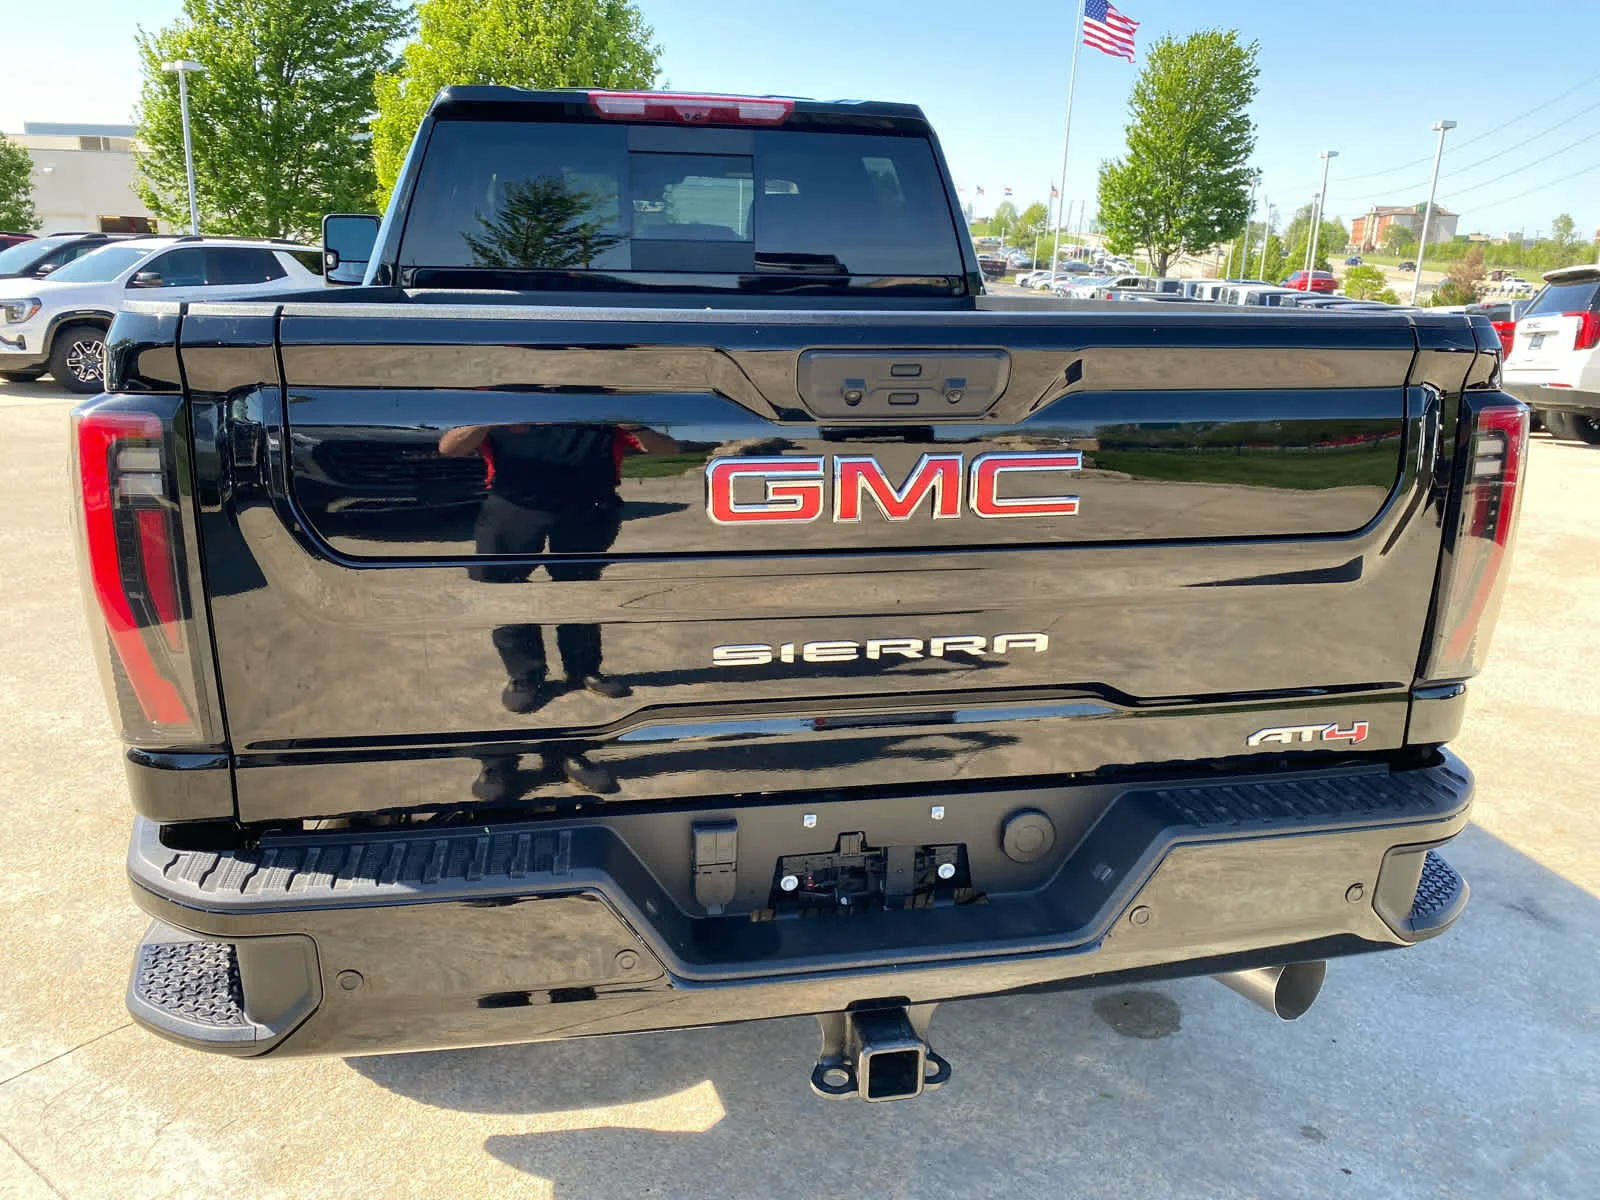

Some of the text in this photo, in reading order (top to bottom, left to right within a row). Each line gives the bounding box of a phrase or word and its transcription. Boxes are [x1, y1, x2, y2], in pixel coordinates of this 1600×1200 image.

[706, 450, 1083, 525] GMC
[713, 632, 1049, 667] SIERRA
[1247, 721, 1369, 747] AT4
